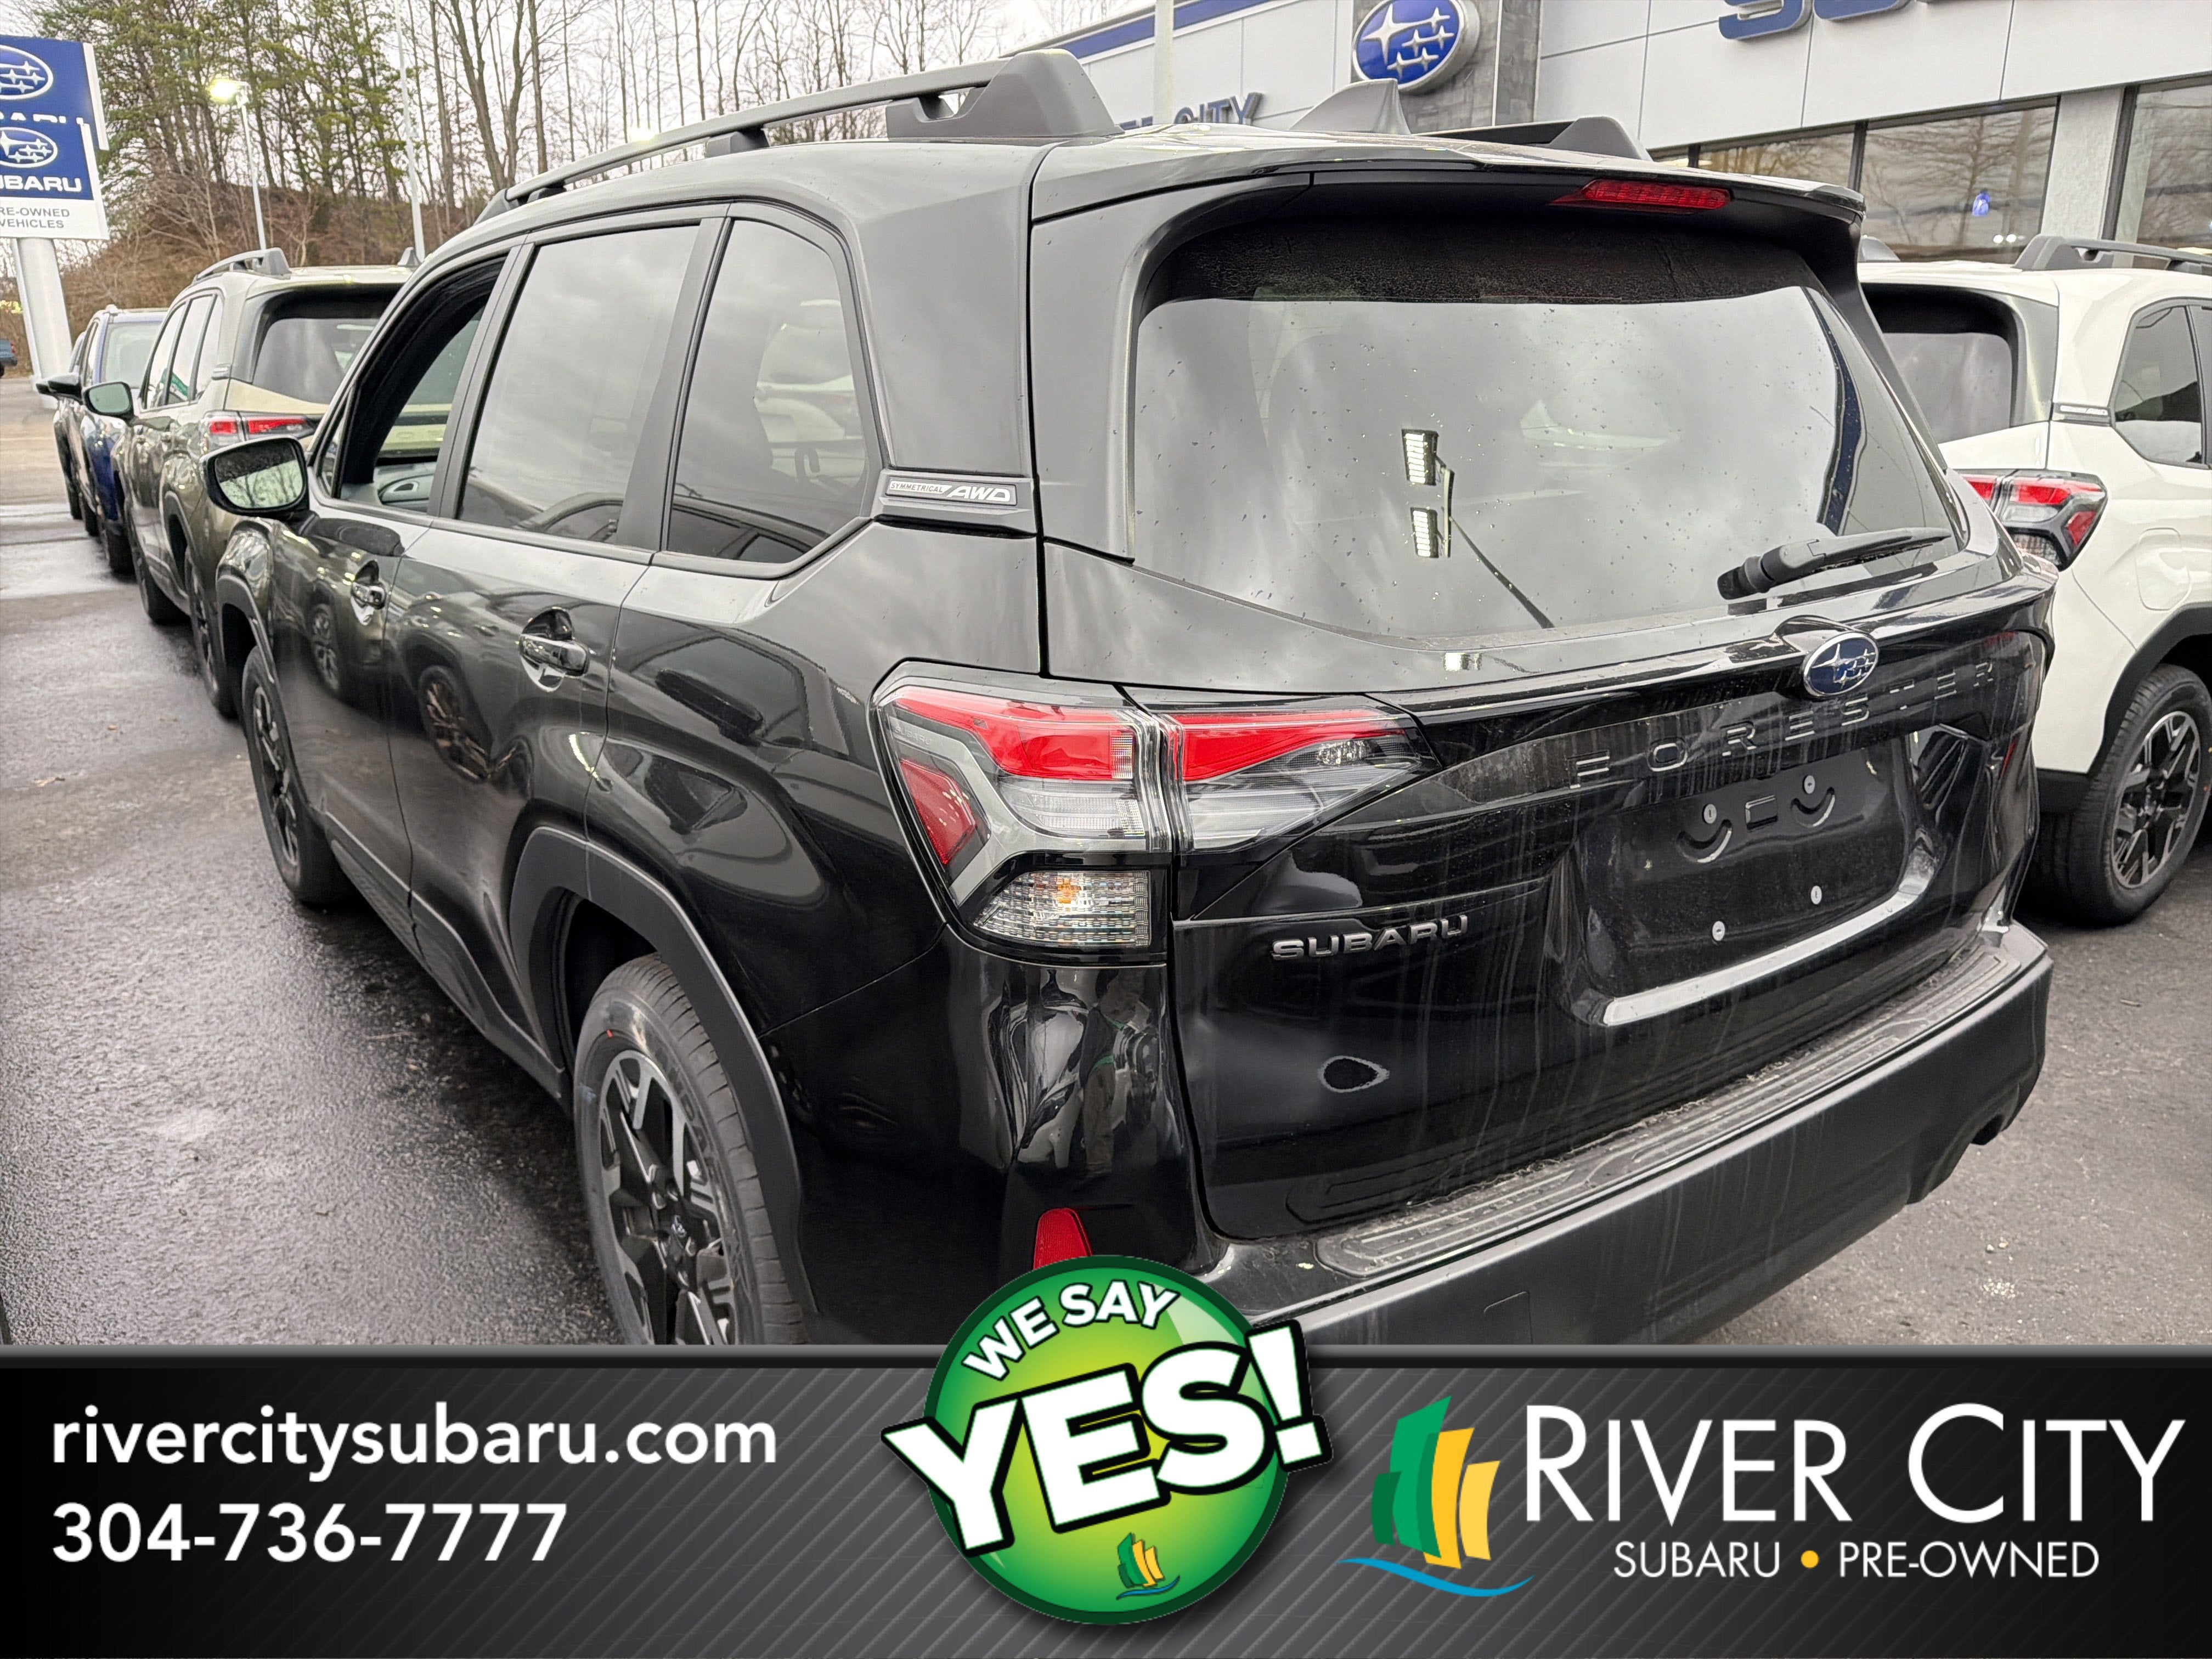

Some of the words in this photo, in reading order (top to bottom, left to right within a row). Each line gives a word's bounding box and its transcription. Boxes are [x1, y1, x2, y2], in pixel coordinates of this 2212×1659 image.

[890, 482, 944, 493] SYMMETRICAL
[946, 486, 1011, 502] AWD
[1566, 662, 1994, 788] FORESTER
[1271, 915, 1468, 961] SUBARU
